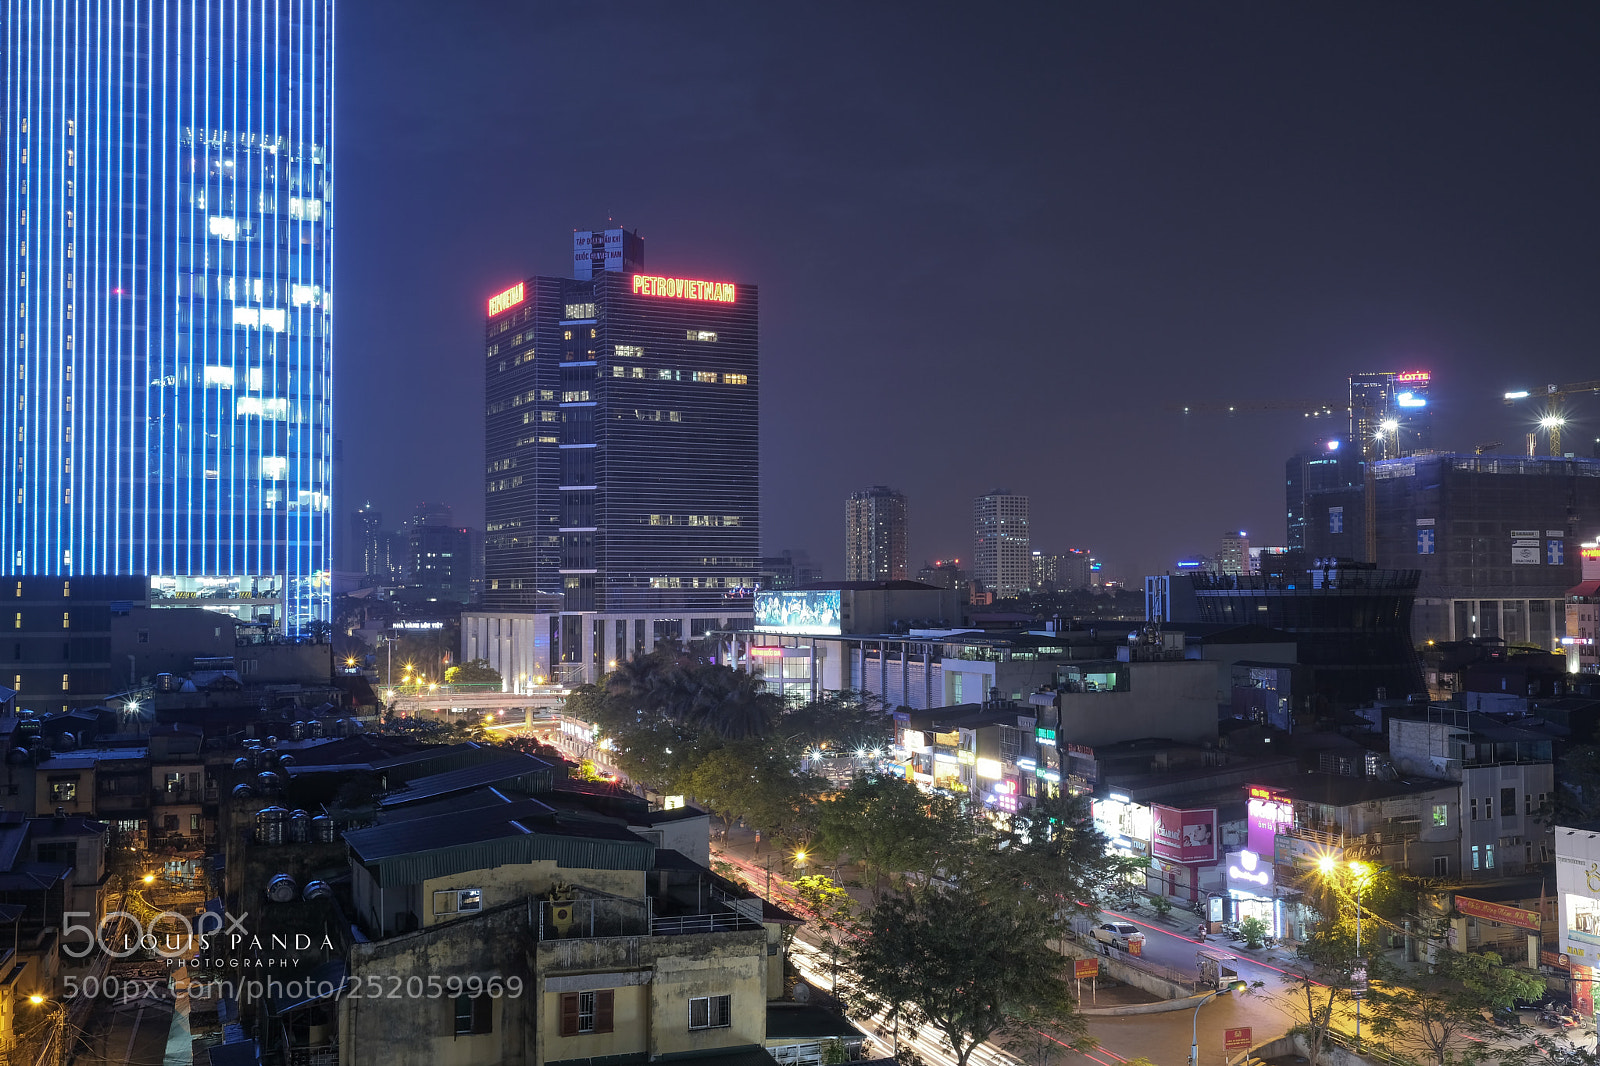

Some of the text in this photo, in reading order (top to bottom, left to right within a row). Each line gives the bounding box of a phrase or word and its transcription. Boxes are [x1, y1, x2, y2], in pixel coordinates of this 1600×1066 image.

[610, 250, 622, 259] NAM
[633, 274, 735, 303] PETROVIETNAM
[1399, 372, 1429, 381] LOTTE
[1566, 946, 1584, 956] NAM
